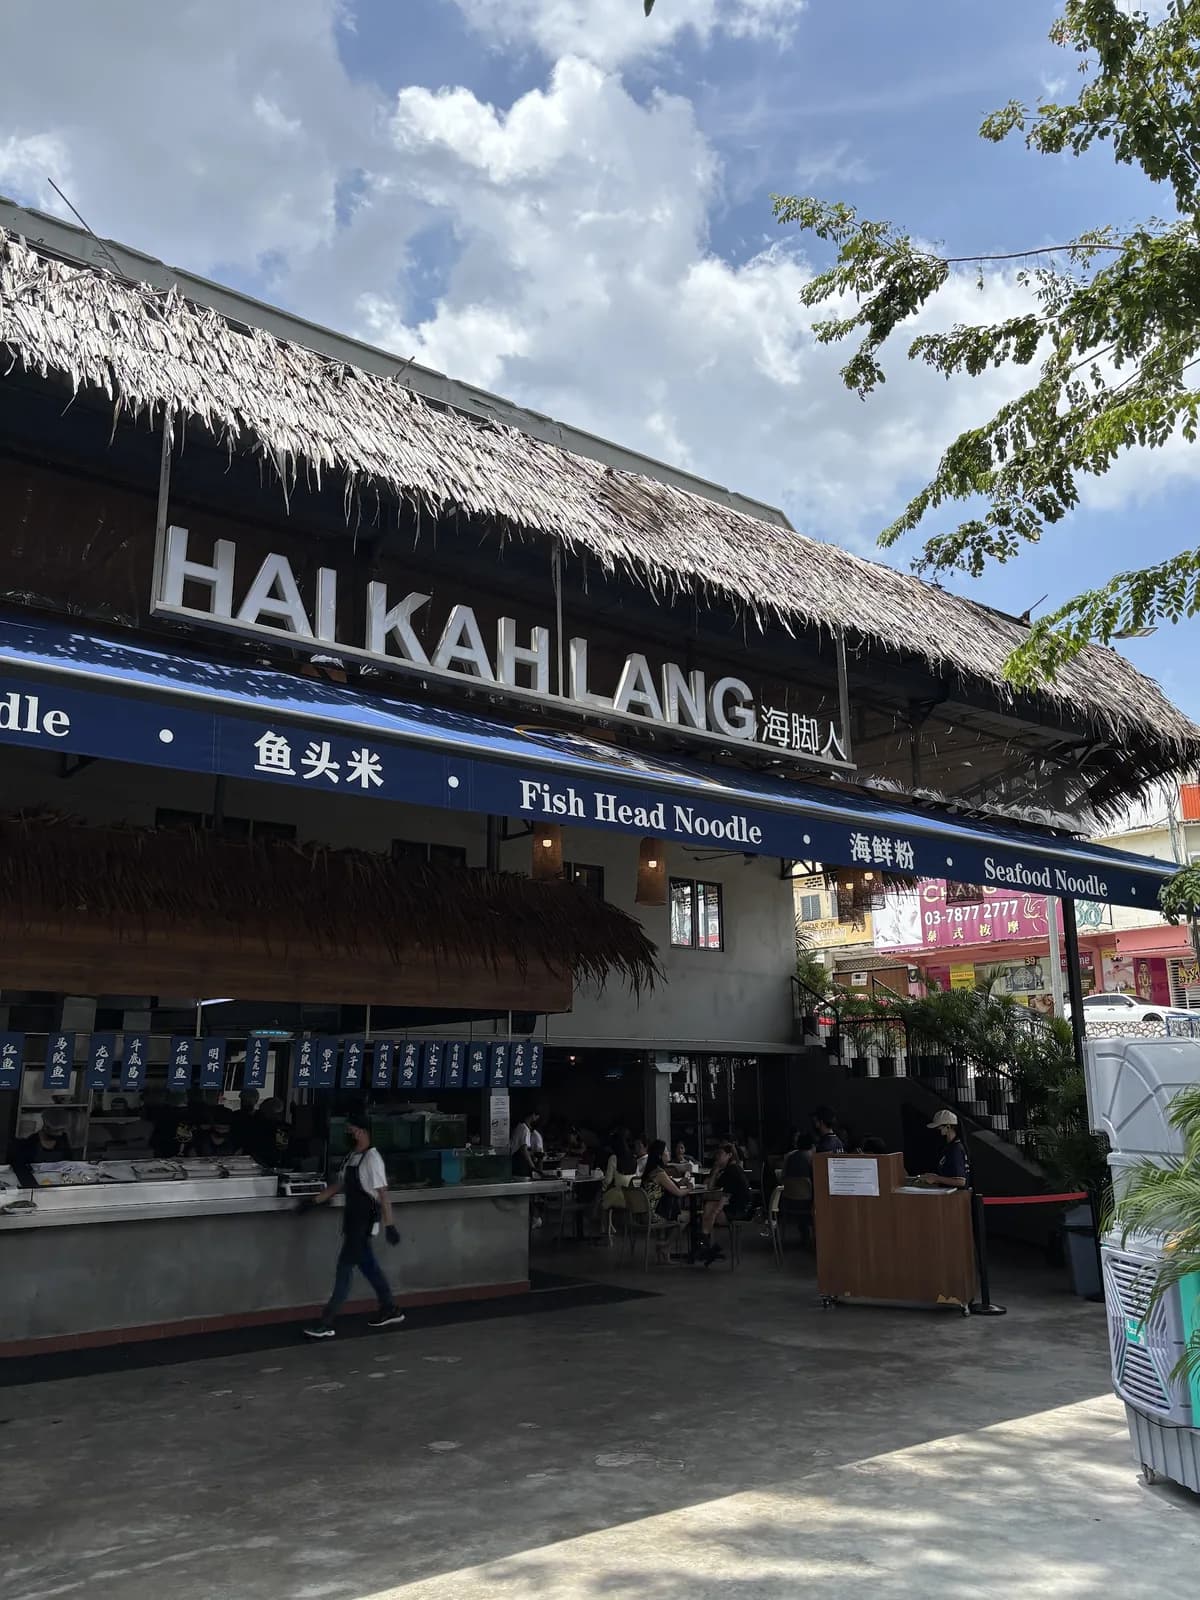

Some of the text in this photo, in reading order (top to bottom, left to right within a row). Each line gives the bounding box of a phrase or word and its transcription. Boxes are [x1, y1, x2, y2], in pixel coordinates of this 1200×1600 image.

[161, 525, 756, 741] HAI KAH LANG
[761, 704, 847, 761] 海脚人
[254, 730, 385, 789] 鱼头米
[519, 780, 763, 845] Fish Head Noodle
[849, 832, 915, 871] 海鲜粉
[984, 857, 1109, 898] Seafood Noodle
[924, 900, 1019, 926] 03-7877 2777
[1025, 956, 1037, 966] 39
[206, 1047, 220, 1073] 明虾
